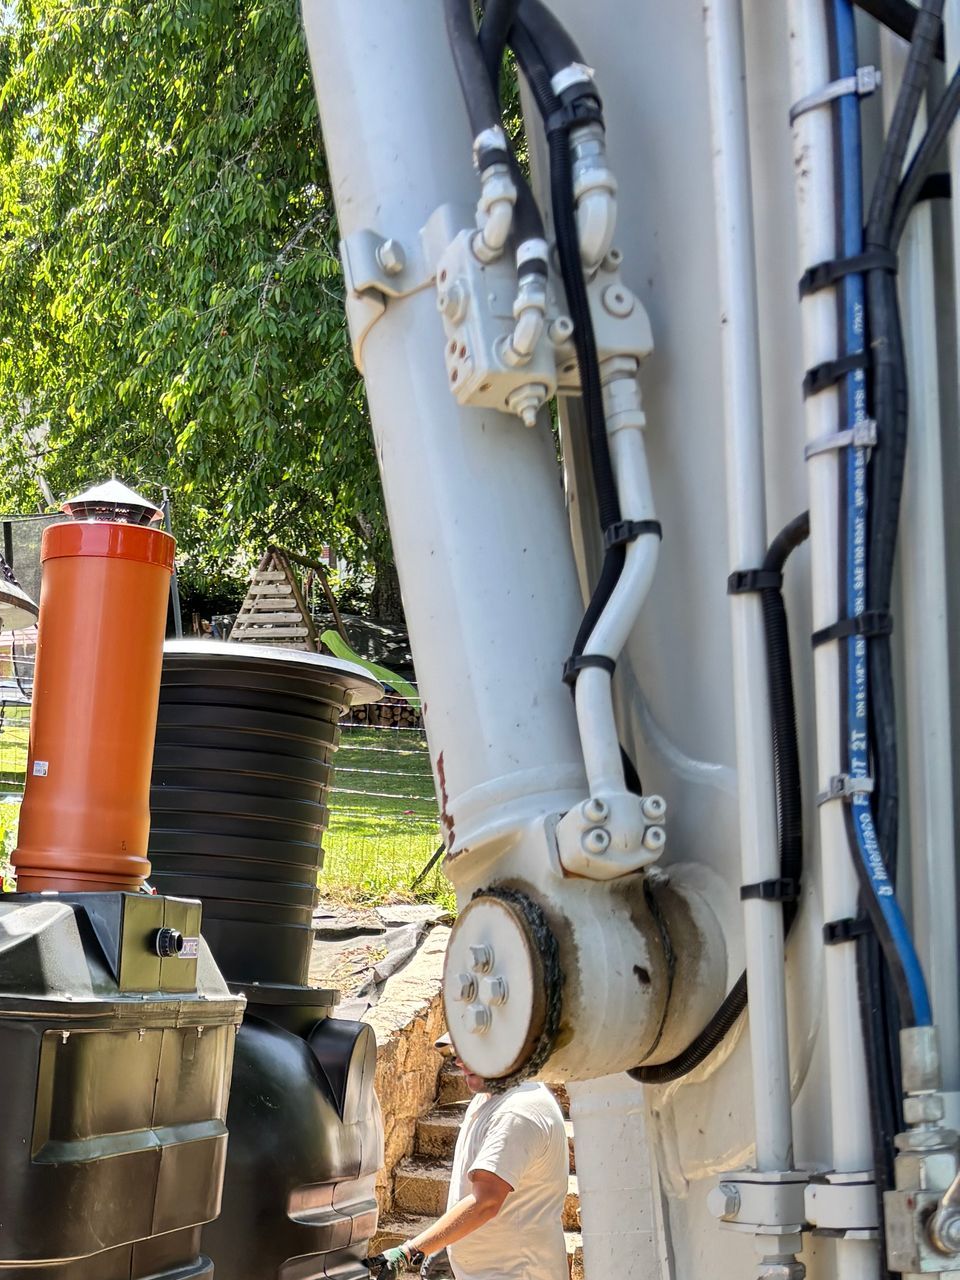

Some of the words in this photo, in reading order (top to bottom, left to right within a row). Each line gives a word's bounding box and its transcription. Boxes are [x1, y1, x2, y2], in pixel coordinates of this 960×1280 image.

[854, 303, 863, 333] ITALY
[855, 389, 864, 409] PSI
[853, 547, 863, 564] 100
[853, 568, 863, 590] SAE
[851, 730, 866, 751] 2T
[180, 943, 197, 953] ORTIE
